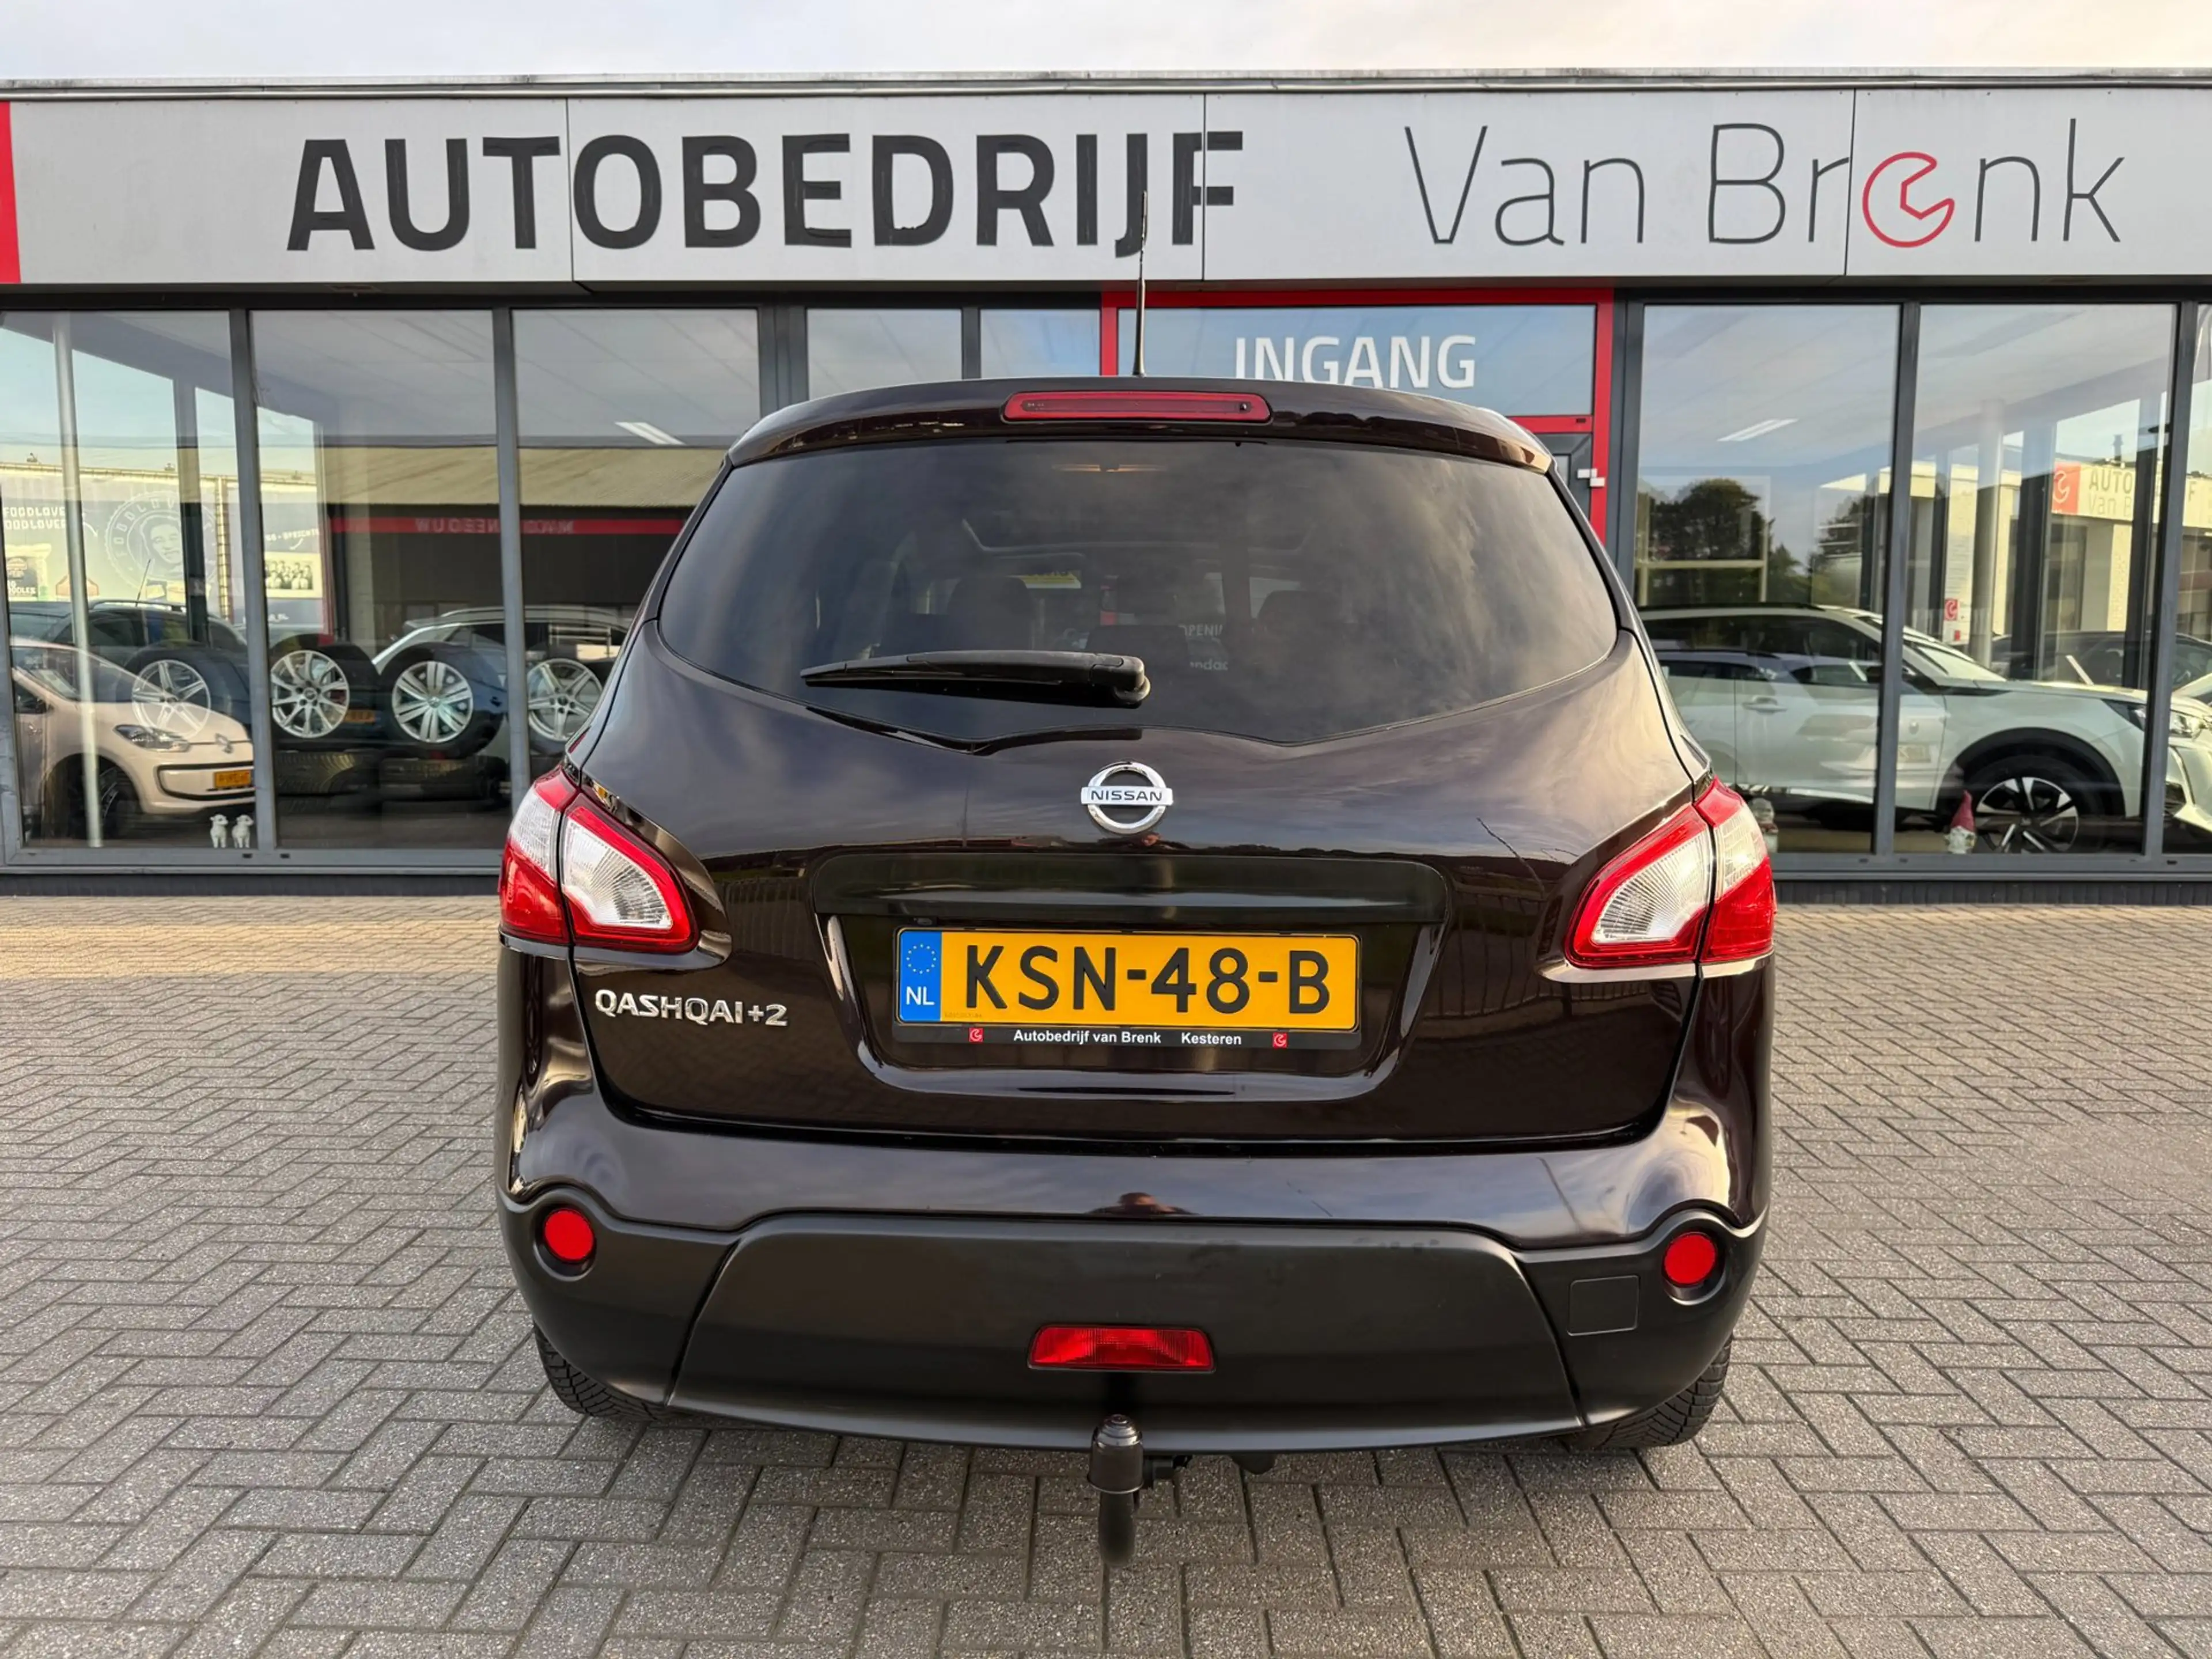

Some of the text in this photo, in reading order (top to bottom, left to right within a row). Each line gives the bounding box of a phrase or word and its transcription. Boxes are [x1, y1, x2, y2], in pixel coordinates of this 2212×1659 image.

[286, 118, 2124, 258] AUTOBEDRIJF Van Brenk
[1236, 336, 1475, 389] INGANG
[3, 506, 66, 517] FOODLOVE
[1090, 790, 1162, 802] NISSAN
[966, 944, 1330, 1014] KSN-48-B
[594, 989, 787, 1027] QASHQAI+2
[906, 986, 934, 1006] NL
[1013, 1029, 1242, 1046] Autobedrijf van Brenk Kesteren
